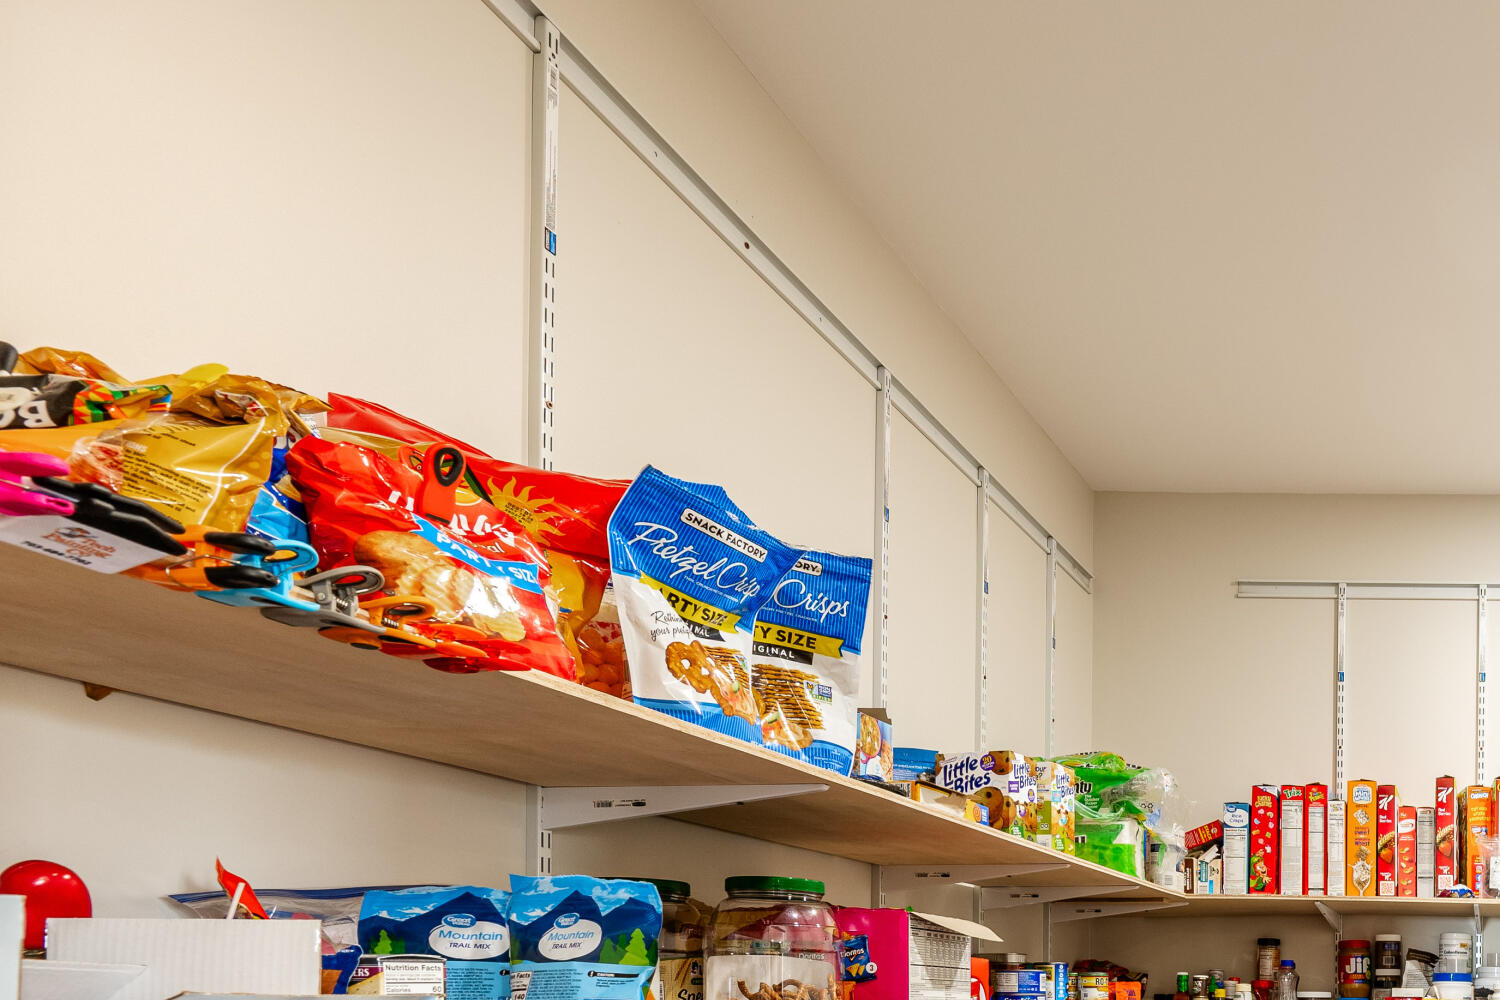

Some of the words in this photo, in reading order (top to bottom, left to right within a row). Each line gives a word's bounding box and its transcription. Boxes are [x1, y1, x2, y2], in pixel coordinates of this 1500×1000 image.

[685, 512, 724, 539] SNACK
[726, 533, 765, 560] FACTORY
[627, 521, 728, 579] Pretzel
[660, 588, 701, 616] RTY
[773, 579, 850, 624] Crisps
[776, 629, 817, 650] SIZE
[753, 645, 795, 659] IGINAL
[981, 755, 992, 766] 20
[943, 756, 978, 787] Little
[1013, 763, 1030, 780] Little
[953, 772, 991, 794] Bites
[1019, 775, 1036, 788] Bites
[1056, 772, 1070, 789] Little
[1075, 778, 1092, 794] nty
[1061, 786, 1075, 798] Bites
[1283, 787, 1302, 799] Trix
[438, 930, 503, 941] Mountain
[548, 930, 594, 942] Mountain
[840, 947, 865, 958] Doritos
[869, 964, 875, 972] 3
[1345, 957, 1371, 974] Jif
